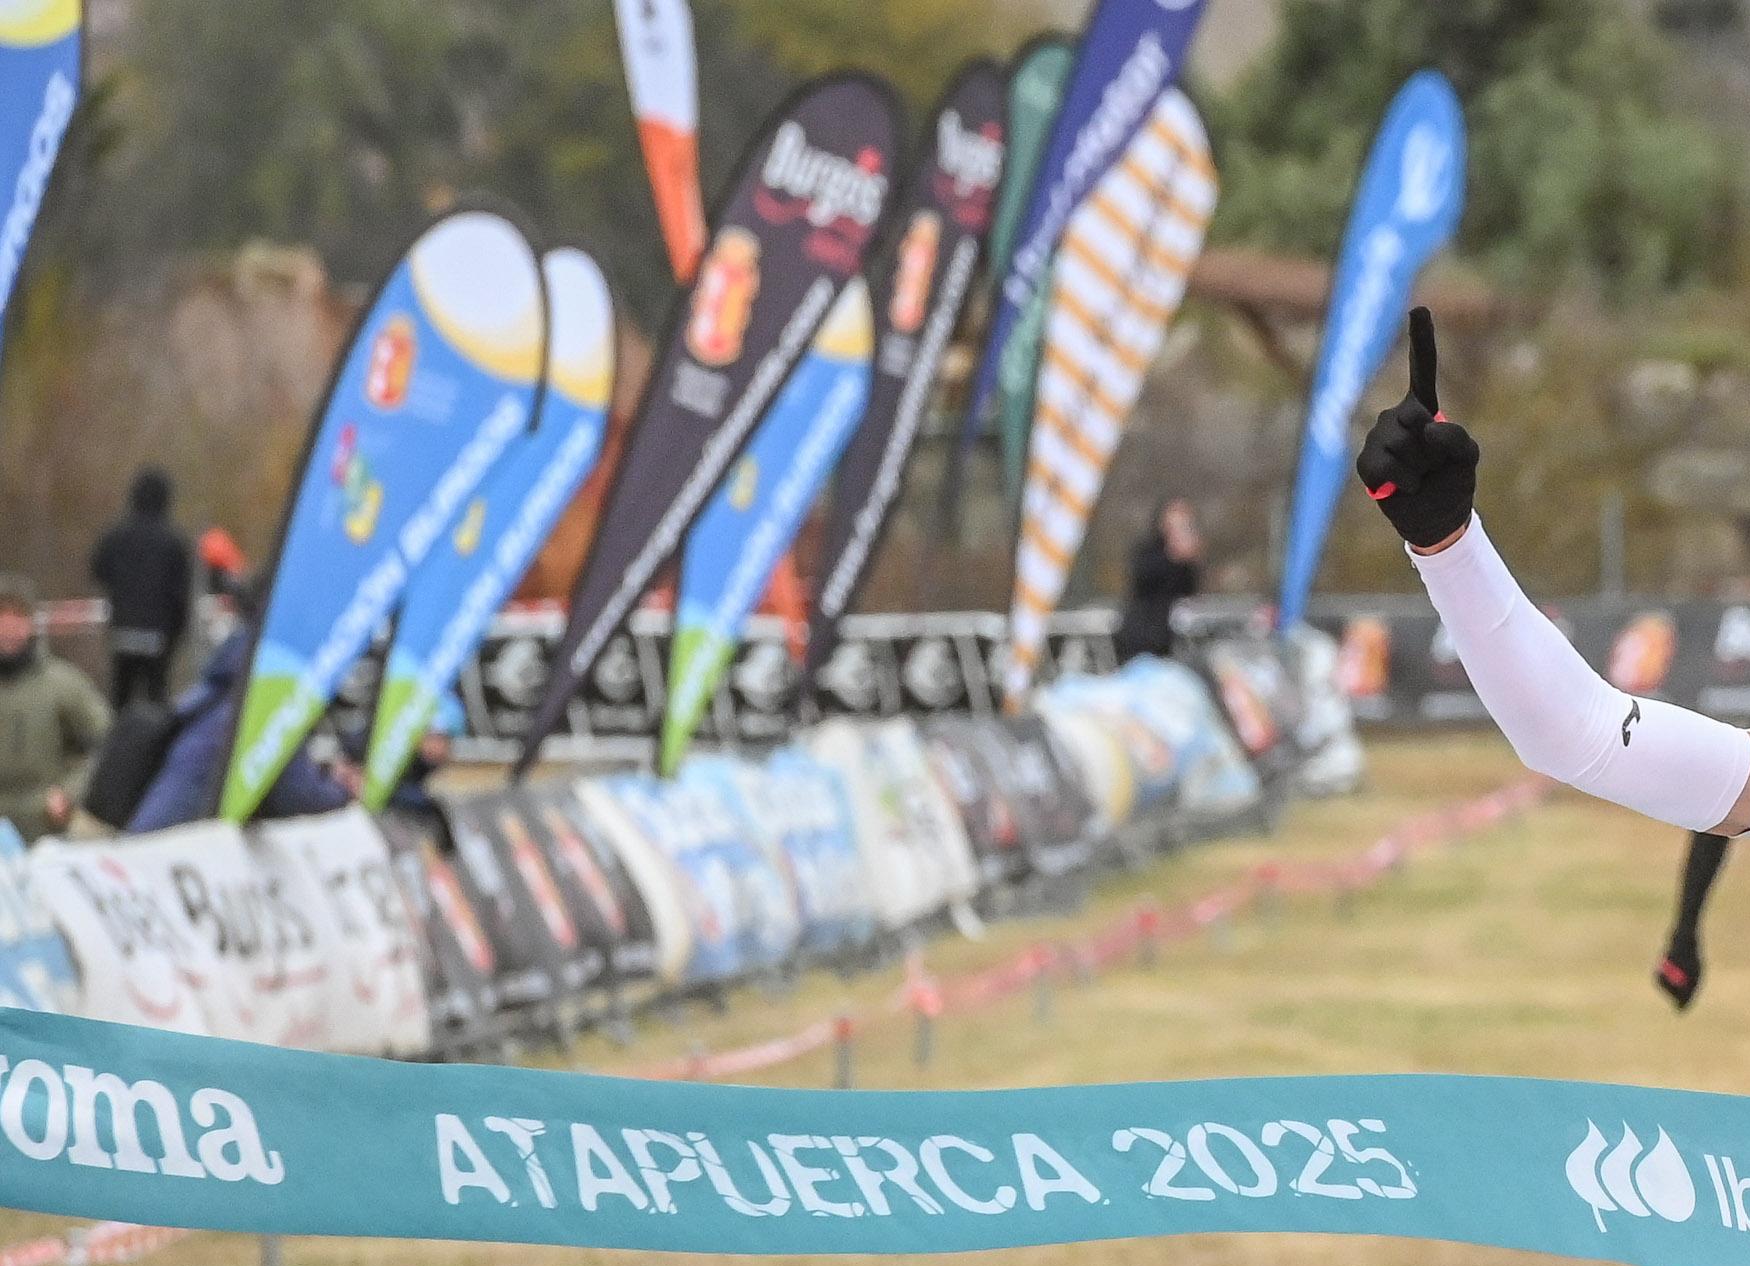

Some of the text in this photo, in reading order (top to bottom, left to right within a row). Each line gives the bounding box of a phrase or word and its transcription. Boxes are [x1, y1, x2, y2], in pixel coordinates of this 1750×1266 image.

[762, 119, 889, 227] Burgos
[0, 1055, 285, 1185] oma
[435, 1112, 1103, 1218] ATAPUERCA
[1112, 1117, 1419, 1201] 2025
